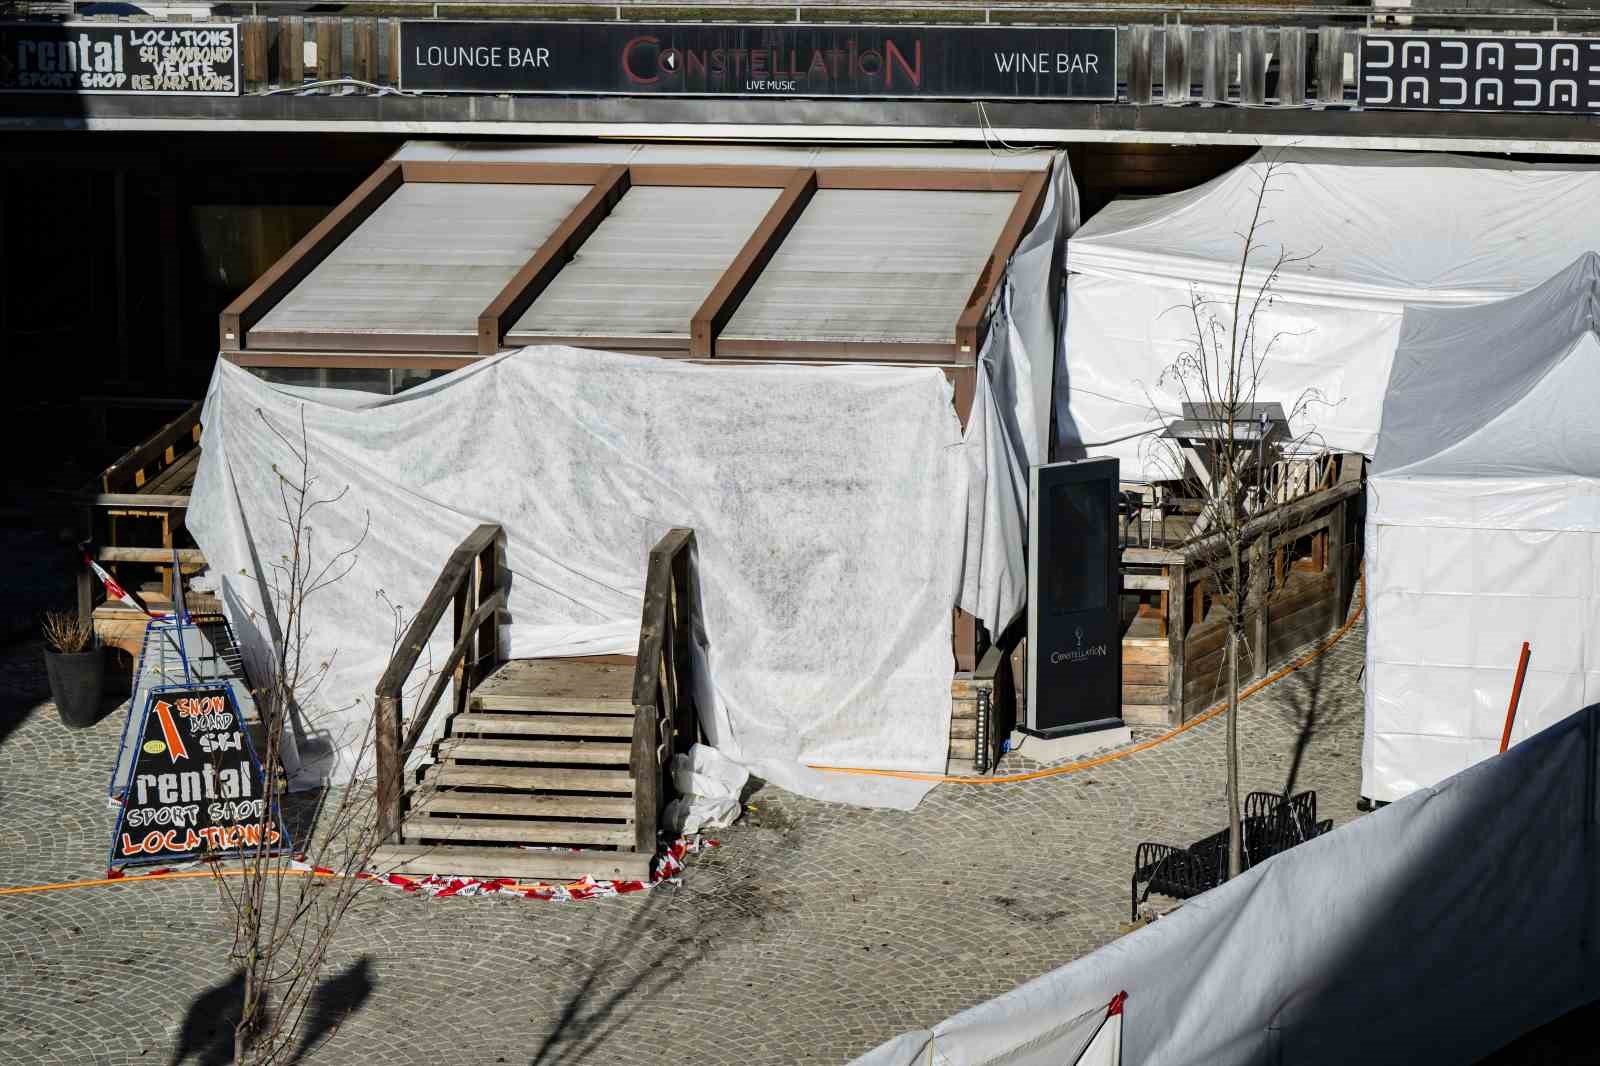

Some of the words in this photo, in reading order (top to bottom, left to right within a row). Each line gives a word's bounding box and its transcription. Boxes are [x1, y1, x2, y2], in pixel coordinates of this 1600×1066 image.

[130, 30, 232, 46] LOCATIONS
[16, 33, 124, 72] rental
[415, 46, 502, 67] LOUNGE
[508, 48, 550, 68] BAR
[994, 52, 1049, 73] WINE
[1056, 53, 1098, 73] BAR
[153, 62, 217, 76] VENTE
[80, 72, 127, 88] SHOP
[131, 74, 234, 91] REPARATIONS
[746, 79, 765, 90] LIVE
[767, 80, 796, 91] MUSIC
[177, 696, 225, 717] SNOW
[190, 714, 232, 733] BOARD
[200, 732, 241, 752] SKI
[137, 763, 251, 804] rental
[127, 805, 198, 827] SPORT
[122, 823, 279, 855] LOCATIONS
